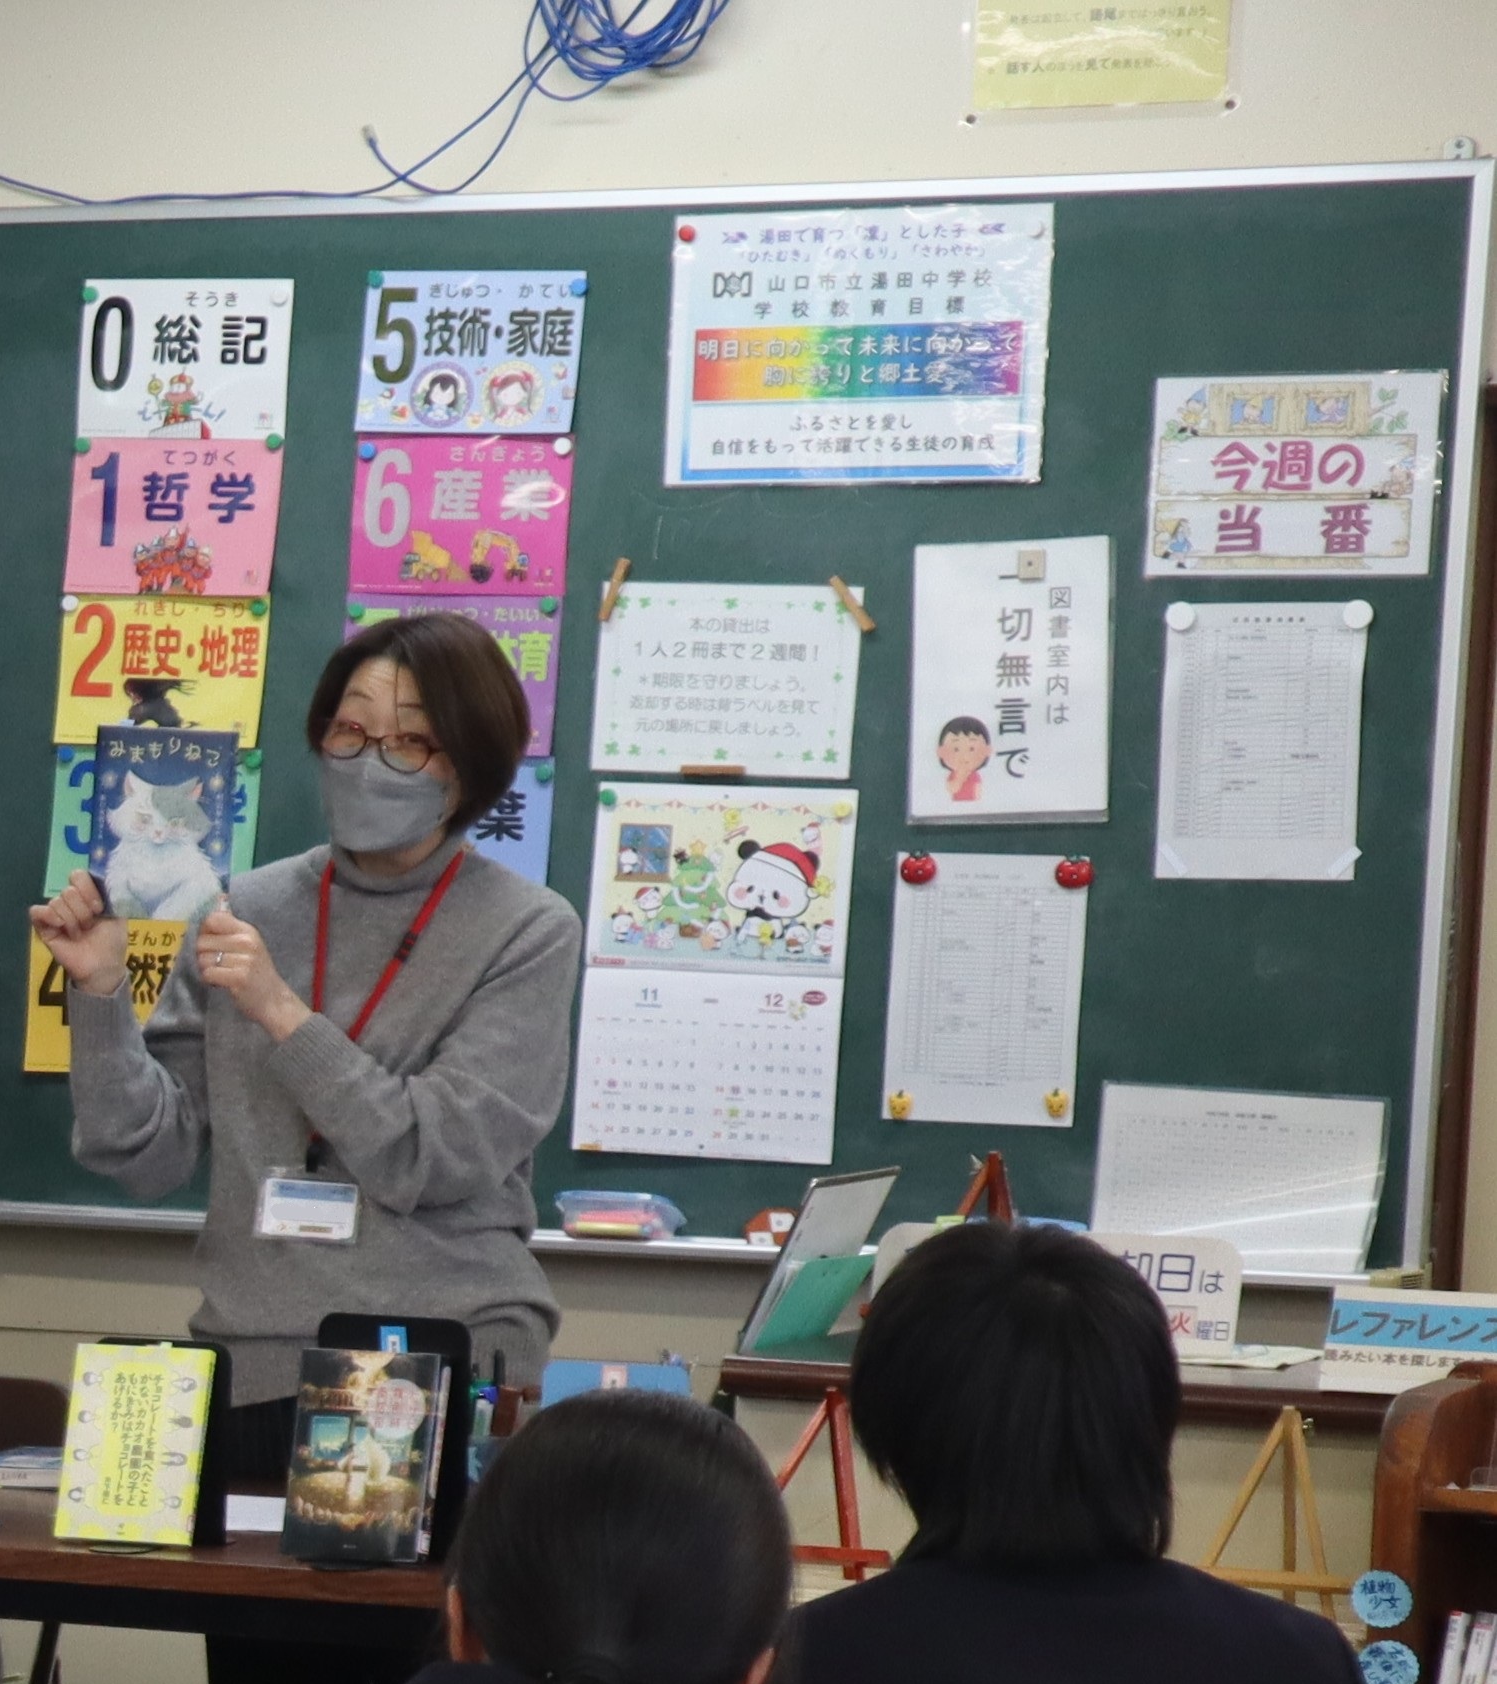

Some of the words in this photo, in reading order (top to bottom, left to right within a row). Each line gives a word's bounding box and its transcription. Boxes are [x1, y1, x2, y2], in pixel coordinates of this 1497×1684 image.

[768, 269, 993, 293] 山口市立湯田中学校
[186, 291, 238, 307] そうき
[754, 296, 966, 319] 学校教育目標
[91, 296, 134, 391] 0
[154, 314, 268, 365] 総記
[372, 287, 418, 385] 5
[423, 307, 576, 358] 技術・家庭
[790, 415, 912, 433] ふるさとを愛し
[449, 446, 546, 462] さんぎょう
[712, 434, 994, 456] 自信をもって活躍できる生徒の育成
[164, 450, 236, 466] てつがく
[1210, 440, 1366, 492] 今週の
[91, 452, 120, 547] 1
[142, 472, 255, 524] 哲学
[363, 447, 413, 549] 6
[430, 468, 555, 523] 産業
[688, 616, 771, 634] 本の貸出は
[70, 603, 116, 698] 2
[122, 624, 260, 679] 歴史・地理
[1046, 586, 1072, 726] 図書室内は
[994, 574, 1034, 779] 一切無言で
[629, 694, 820, 715] 返却する時は背ラベルを見て
[634, 717, 802, 738] 元の場所に戻しましょう。
[109, 737, 222, 767] みまもりねこ
[640, 987, 659, 1002] 11
[764, 993, 784, 1007] 12
